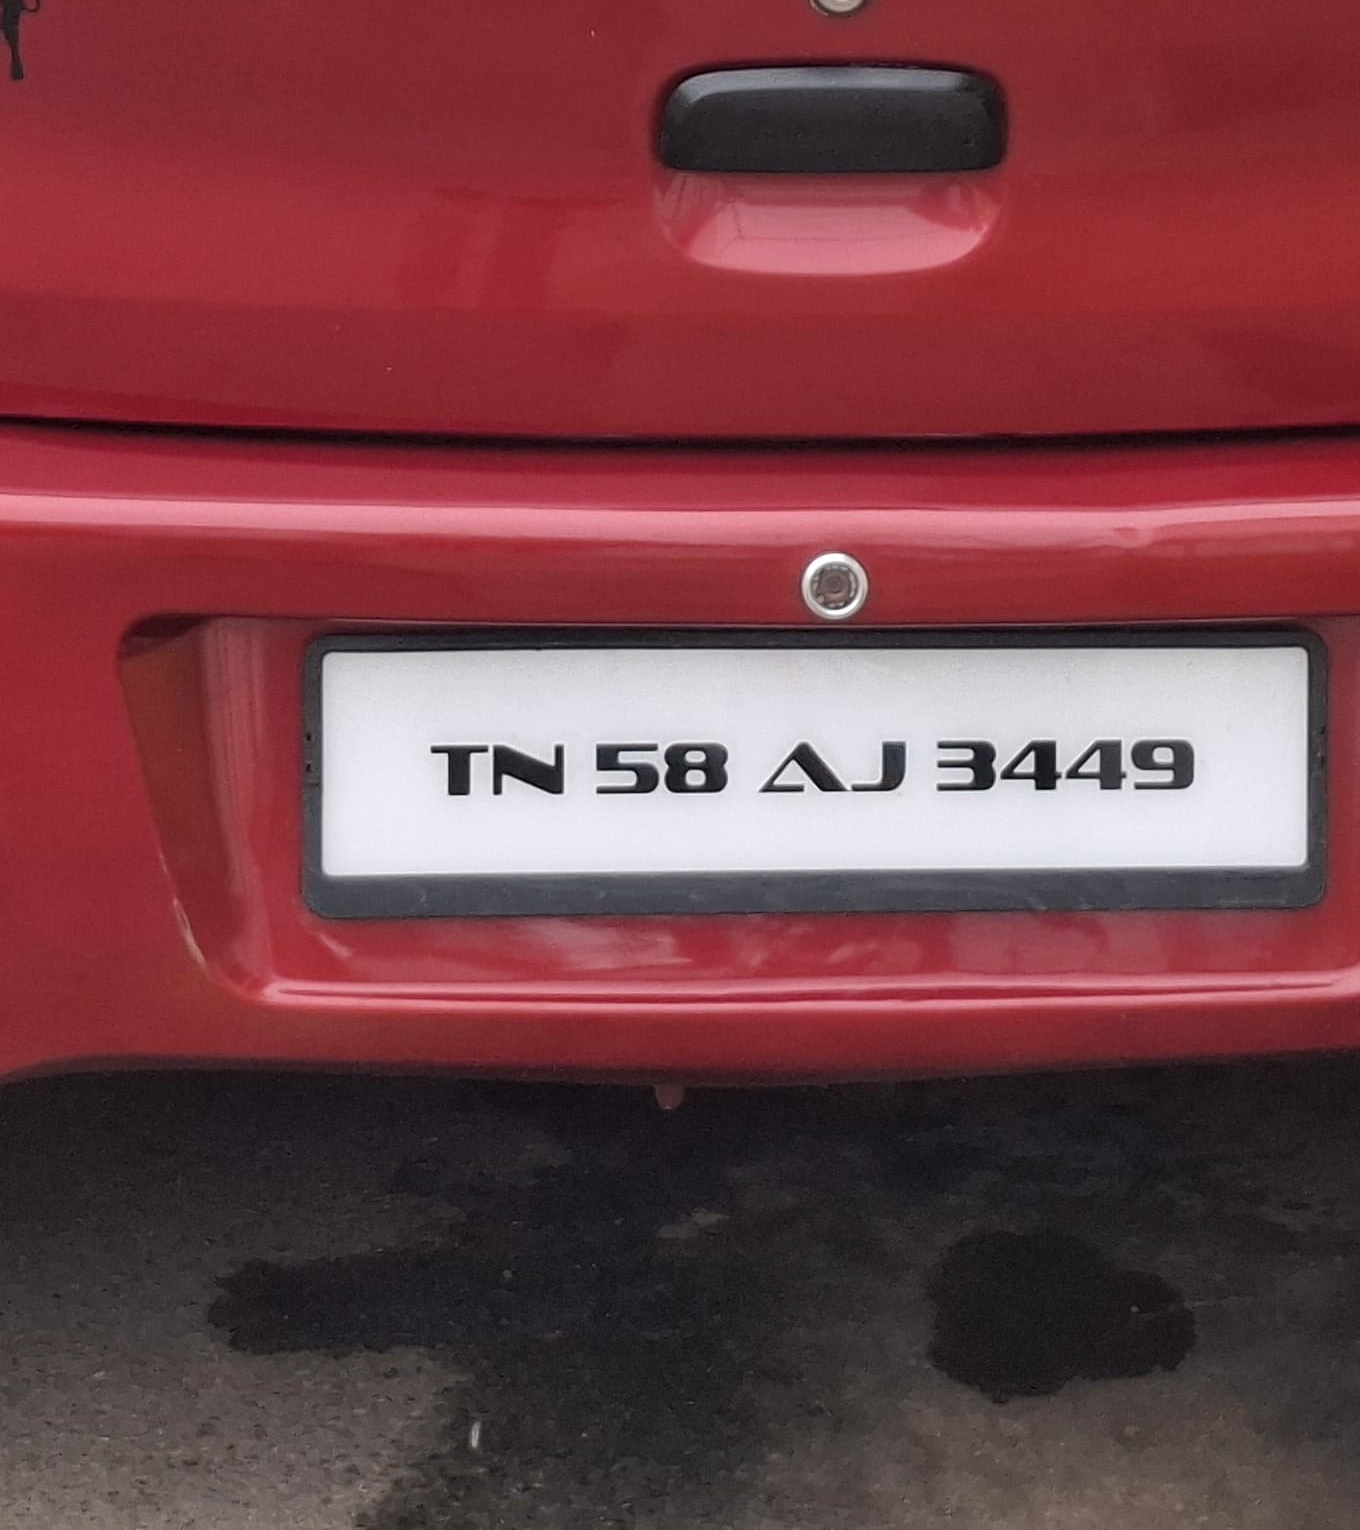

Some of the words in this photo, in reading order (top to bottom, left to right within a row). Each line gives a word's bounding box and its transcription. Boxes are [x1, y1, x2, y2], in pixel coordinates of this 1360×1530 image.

[429, 743, 565, 797] TN
[594, 741, 729, 795] 58
[757, 739, 908, 794] AJ
[935, 737, 1196, 792] 3449
